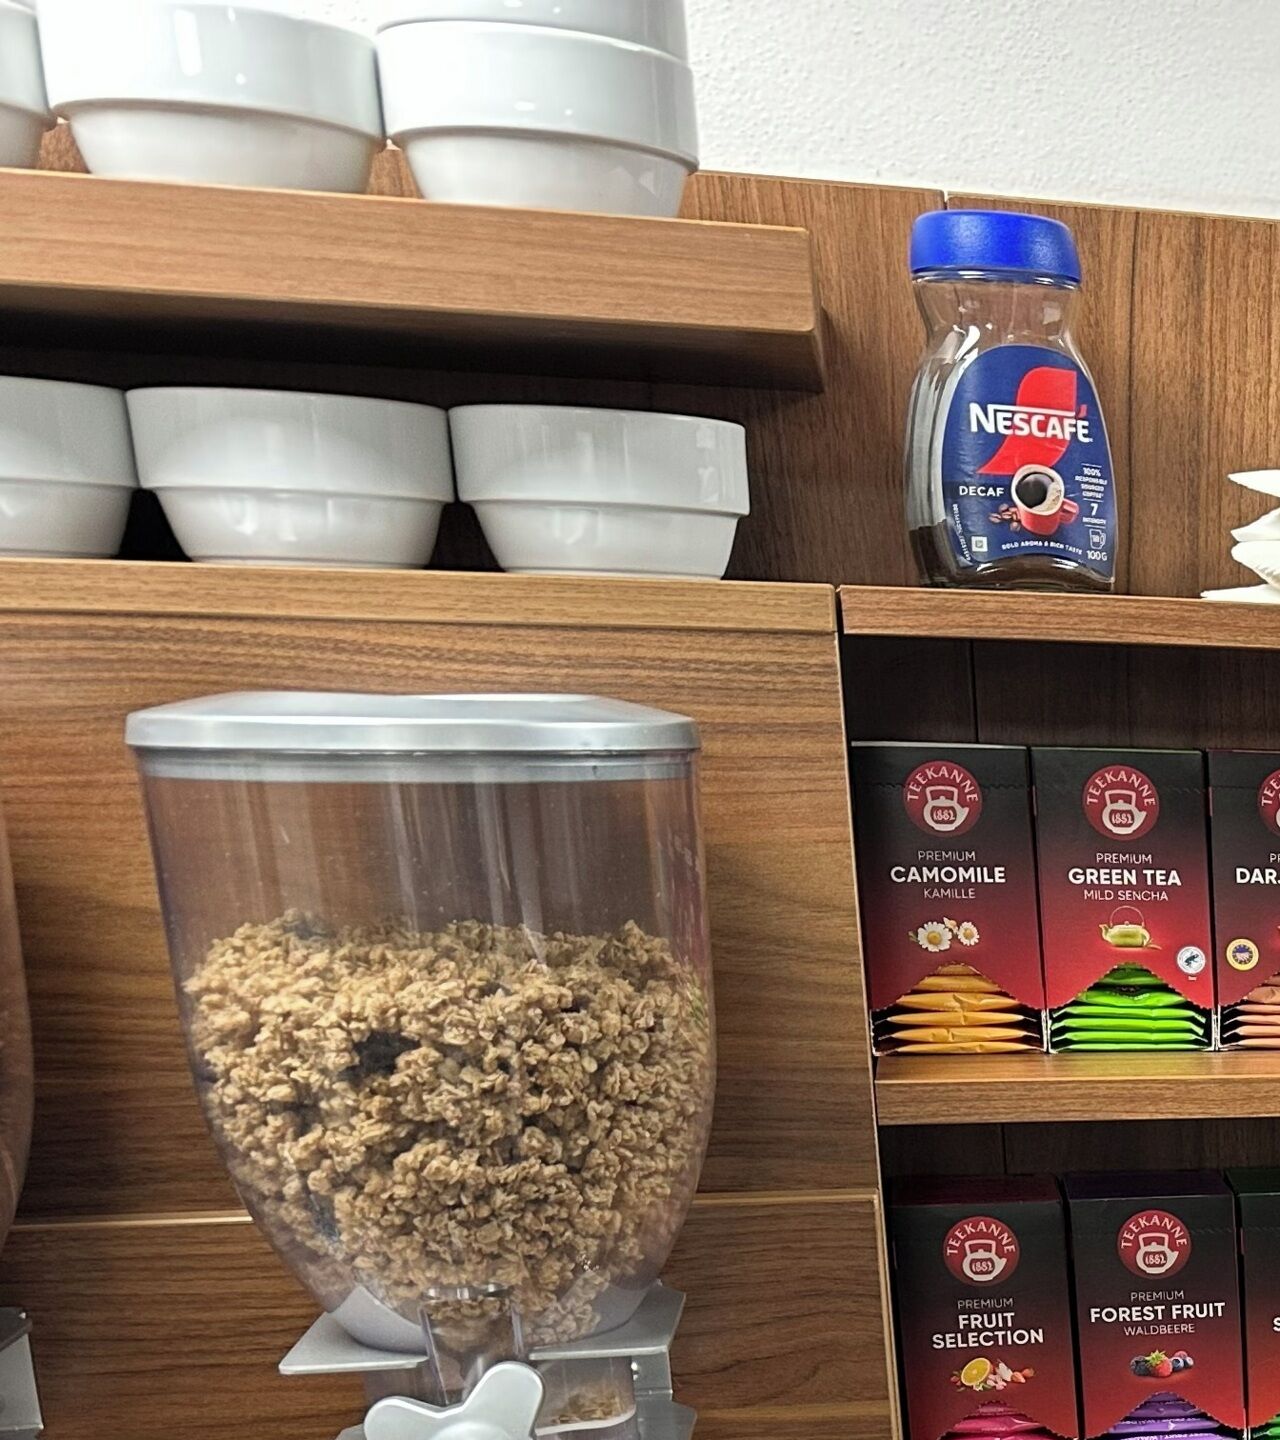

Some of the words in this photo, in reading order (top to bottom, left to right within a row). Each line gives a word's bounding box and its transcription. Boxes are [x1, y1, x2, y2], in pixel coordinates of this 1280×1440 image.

[968, 402, 1094, 443] NESCAFÉ
[958, 485, 1005, 498] DECAF
[1090, 503, 1099, 516] 7
[906, 765, 979, 802] TEEKANNE
[1086, 769, 1156, 806] TEEKANNE
[932, 809, 955, 821] 1882
[1111, 813, 1133, 825] 1882
[917, 850, 976, 862] PREMIUM
[1095, 852, 1153, 865] PREMIUM
[890, 865, 1006, 884] CAMOMILE
[1067, 867, 1138, 885] GREEN
[1142, 869, 1182, 886] TEA
[923, 887, 976, 900] KAMILLE
[1083, 889, 1115, 901] MILD
[1117, 889, 1169, 902] SENCHA
[946, 1220, 1016, 1256] TEEKANNE
[1120, 1214, 1188, 1249] TEEKANNE
[1129, 1289, 1185, 1302] PREMIUM
[957, 1297, 1014, 1310] PREMIUM
[1089, 1304, 1166, 1323] FOREST
[1171, 1302, 1226, 1320] FRUIT
[957, 1312, 1015, 1330] FRUIT
[1123, 1323, 1196, 1336] WALDBEERE
[931, 1328, 1045, 1349] SELECTION
